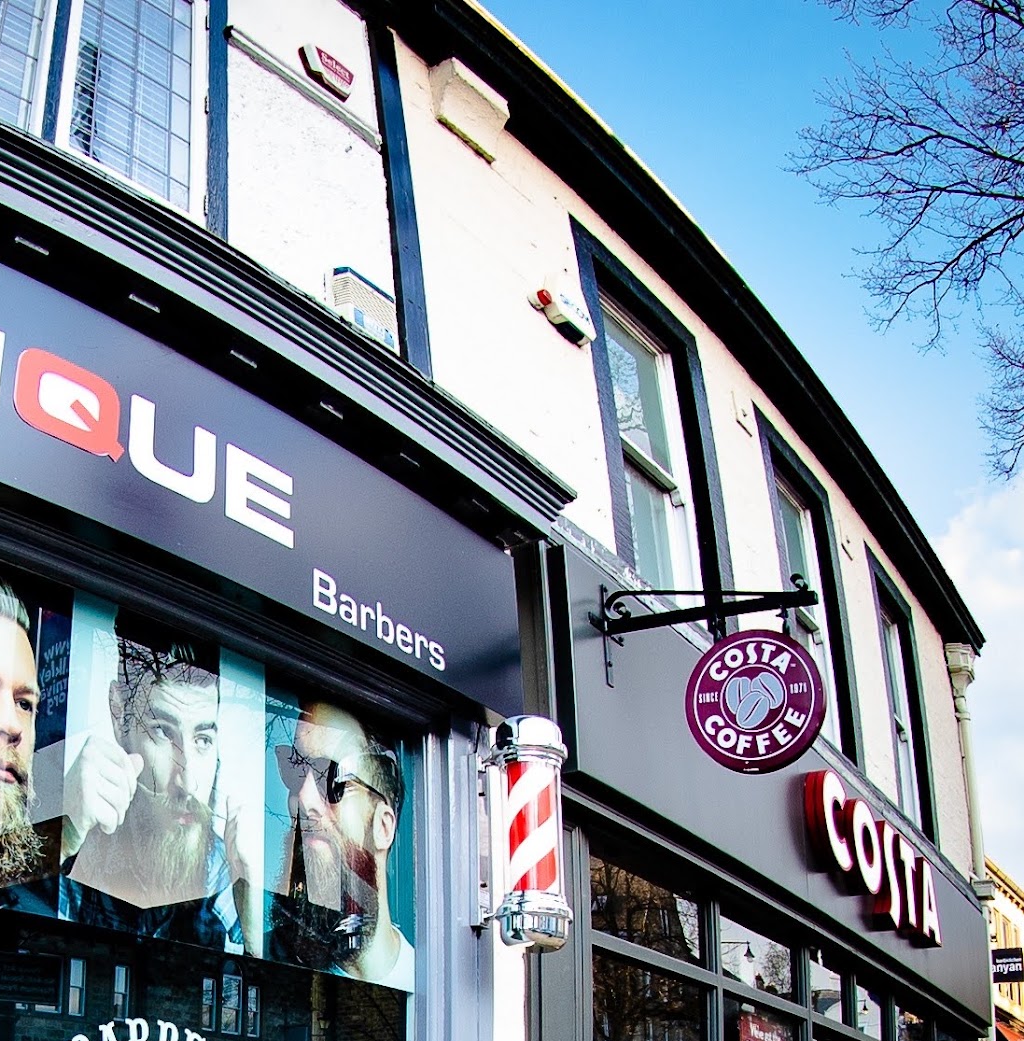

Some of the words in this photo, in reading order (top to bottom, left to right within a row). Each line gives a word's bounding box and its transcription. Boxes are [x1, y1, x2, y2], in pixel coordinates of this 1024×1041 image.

[312, 567, 447, 673] Barbers
[709, 643, 792, 681] COSTA
[698, 691, 719, 704] SINCE
[789, 682, 807, 694] 1971
[704, 707, 807, 755] COFFEE
[821, 771, 943, 947] COSTA
